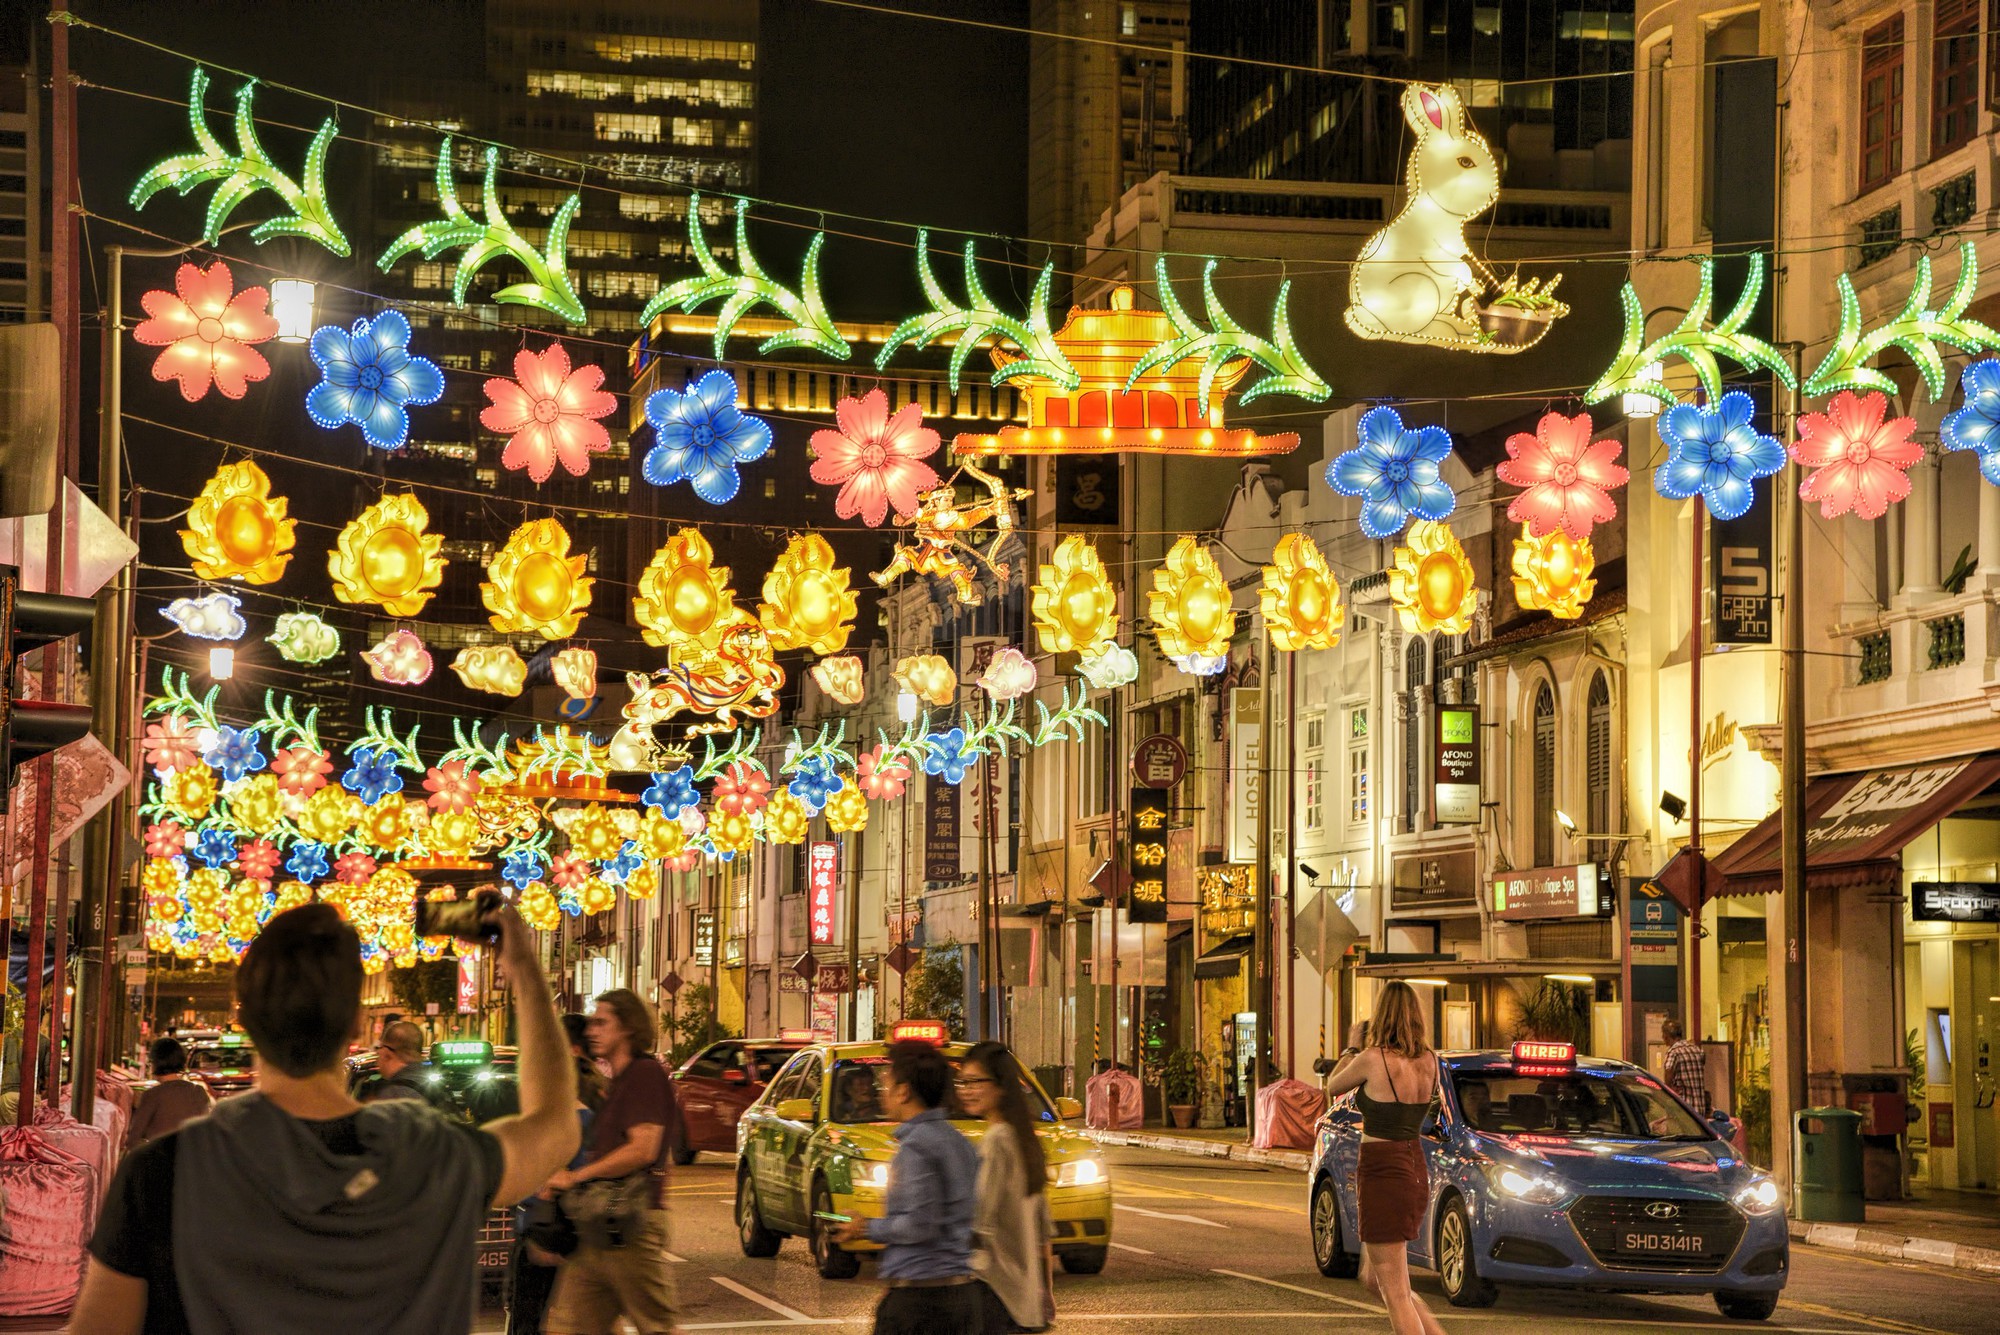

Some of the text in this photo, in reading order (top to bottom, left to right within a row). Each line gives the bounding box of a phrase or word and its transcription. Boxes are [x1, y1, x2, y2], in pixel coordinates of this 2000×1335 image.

[1722, 547, 1767, 596] 5
[1722, 597, 1767, 610] FOOT
[1722, 609, 1756, 621] WAY
[1442, 750, 1473, 760] AFOND
[1442, 759, 1473, 769] Boutique
[1246, 738, 1261, 820] HOSTEL
[1450, 768, 1465, 777] Spa
[934, 774, 954, 838] 紫經閣
[1134, 806, 1167, 903] 金裕源
[935, 866, 952, 876] 249
[1508, 879, 1533, 897] AFOND
[1534, 877, 1561, 898] Boutique
[1562, 875, 1575, 897] Spa
[94, 903, 102, 931] 28
[1520, 1044, 1568, 1059] HIRED
[1626, 1233, 1658, 1250] SHD
